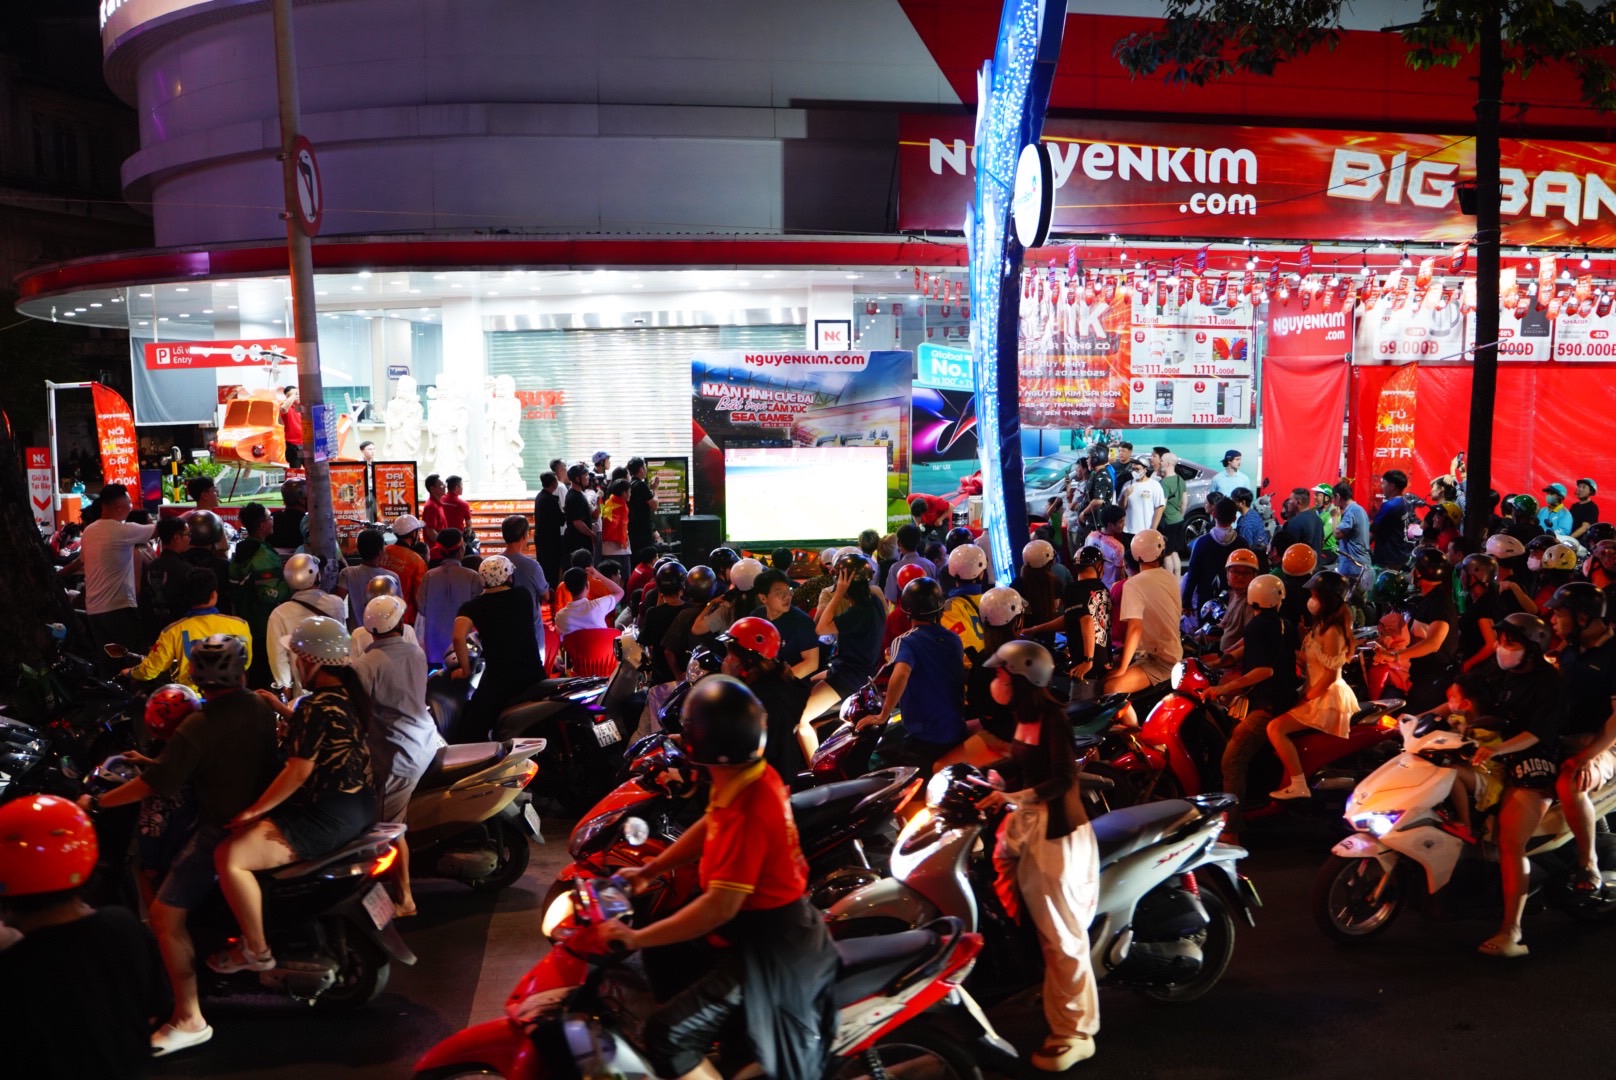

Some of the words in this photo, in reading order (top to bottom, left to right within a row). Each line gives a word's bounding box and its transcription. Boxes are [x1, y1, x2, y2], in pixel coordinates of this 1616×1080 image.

[1327, 149, 1460, 209] BIG
[1179, 192, 1257, 215] .com
[1208, 315, 1236, 325] 11.000đ
[824, 330, 841, 341] NK
[1325, 330, 1345, 340] .com
[1380, 341, 1439, 354] 69.000Đ
[173, 356, 192, 365] Entry
[931, 350, 963, 361] Global
[1145, 364, 1180, 374] 111.000đ
[1194, 365, 1234, 374] 1.111.000đ
[702, 382, 741, 398] MÀN
[743, 386, 772, 401] HÌNH
[731, 412, 756, 422] SEA
[758, 413, 794, 422] GAMES
[1132, 414, 1172, 423] 1.111.000đ
[1192, 414, 1233, 423] 1.111.000đ
[1376, 448, 1412, 458] 2TR
[32, 454, 46, 464] NK
[384, 490, 406, 504] 1K
